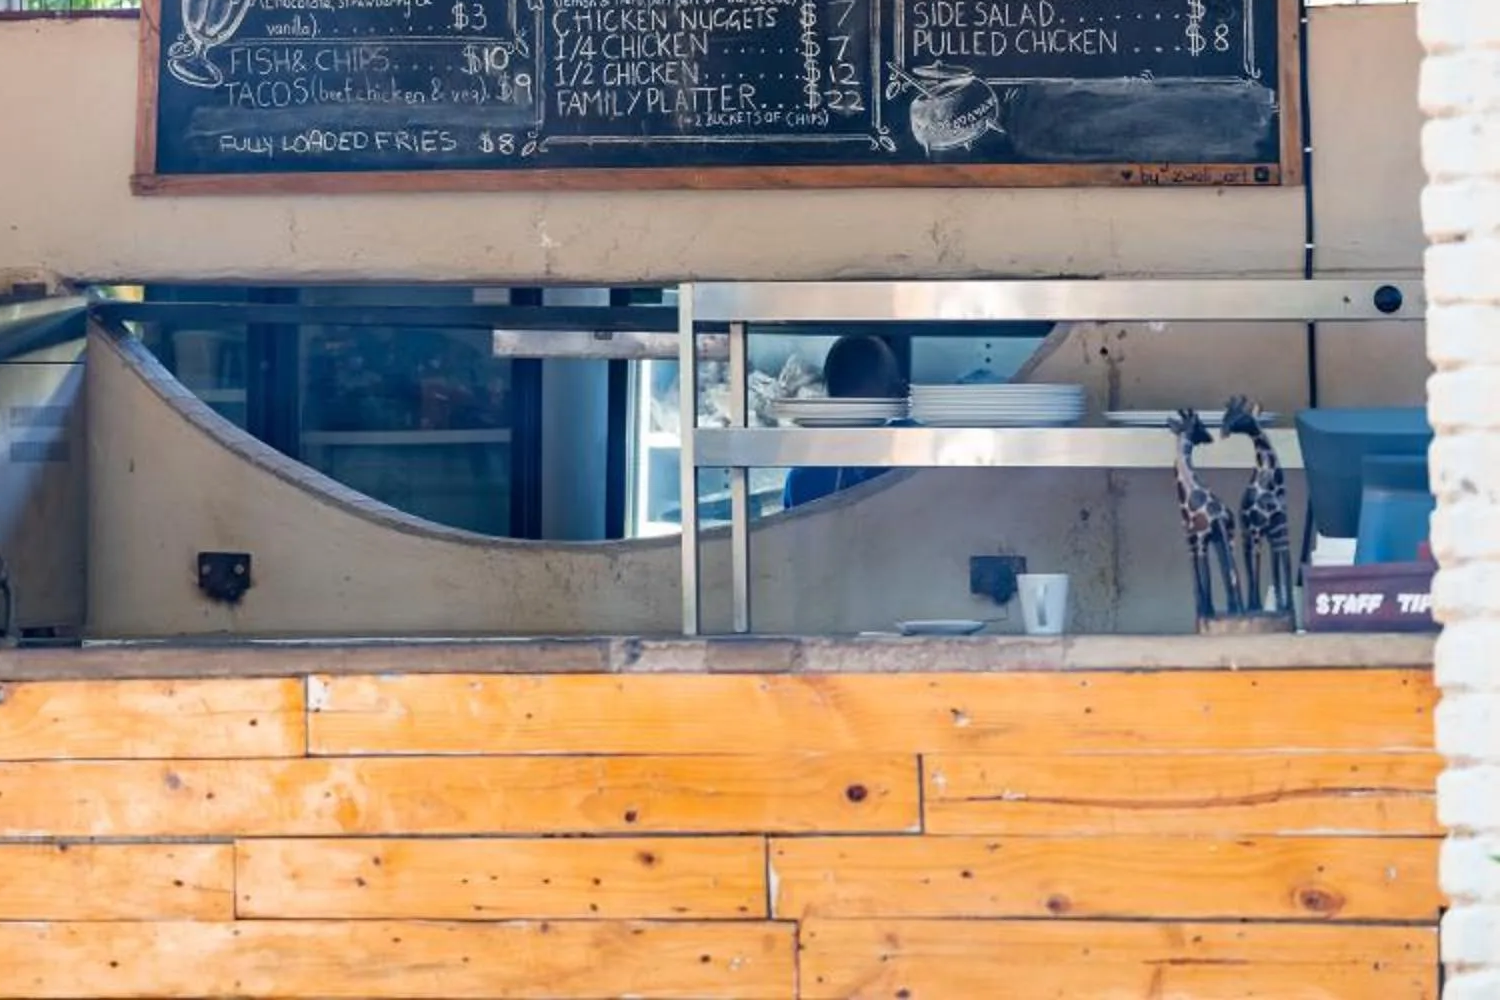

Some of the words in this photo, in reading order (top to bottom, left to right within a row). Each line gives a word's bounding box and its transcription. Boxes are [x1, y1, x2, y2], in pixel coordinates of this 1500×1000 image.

[451, 2, 488, 32] $3
[552, 8, 668, 36] CHICKEN
[680, 6, 779, 34] NUGGETS
[913, 1, 969, 28] SIDE
[973, 1, 1056, 28] SALAD
[554, 34, 597, 63] 1/4
[601, 31, 708, 59] CHICKEN
[912, 29, 1007, 57] PULLED
[1014, 29, 1118, 56] CHICKEN
[230, 46, 290, 75] FISH
[315, 46, 390, 73] CHIPS
[459, 45, 510, 75] $10
[555, 61, 594, 87] 1/2
[603, 60, 700, 86] CHICKEN
[224, 77, 310, 108] TACOS
[557, 89, 642, 118] FAMILY
[646, 83, 758, 115] PLATTER
[219, 135, 273, 159] FULLY
[282, 129, 370, 153] LOADED
[374, 129, 458, 153] FRIES
[1315, 593, 1385, 615] STAFF
